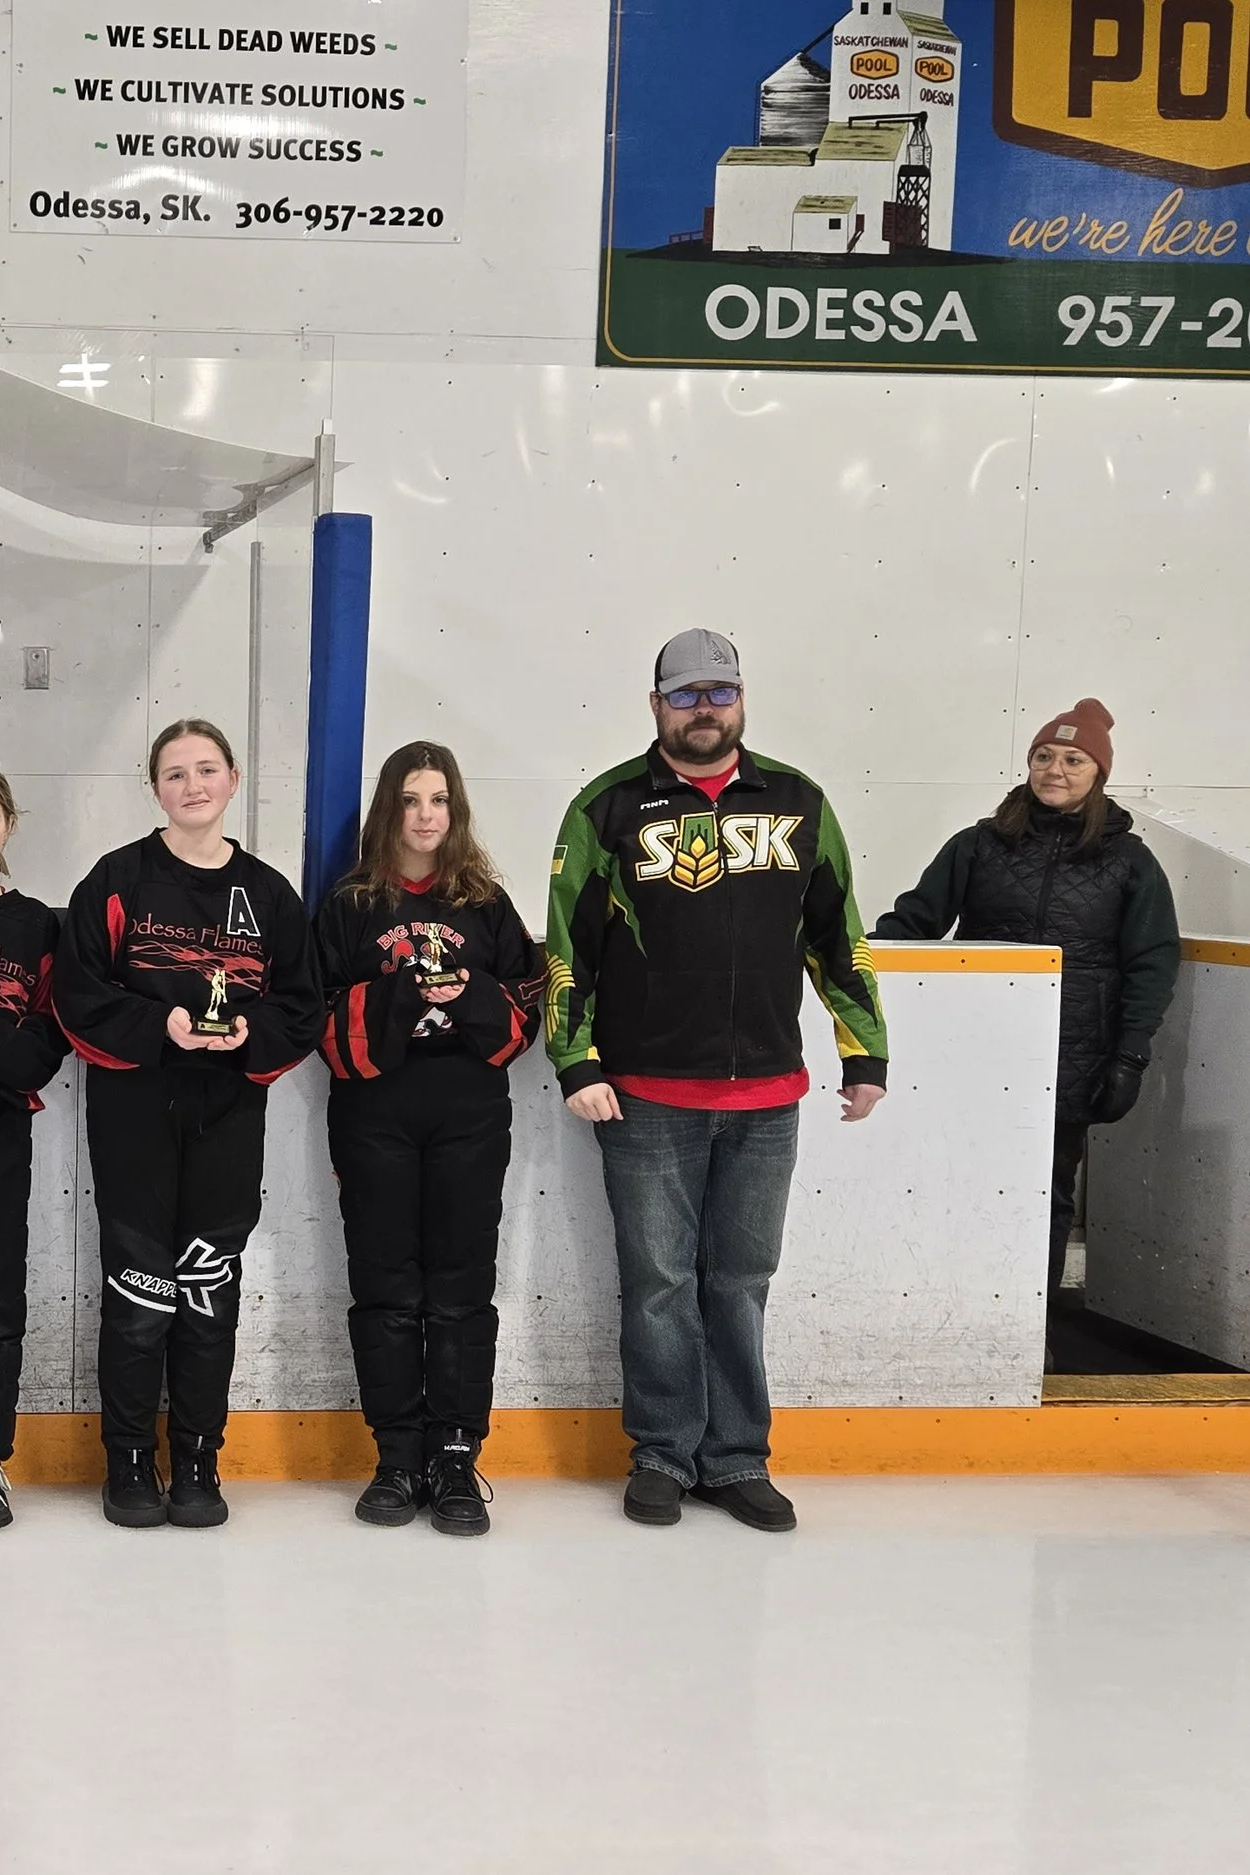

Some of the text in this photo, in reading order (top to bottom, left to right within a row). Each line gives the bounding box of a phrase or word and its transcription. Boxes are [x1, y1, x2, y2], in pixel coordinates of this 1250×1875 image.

[106, 25, 376, 56] WE SELL DEAD WEEDS
[833, 35, 908, 48] SASKATCHEWAN
[856, 57, 892, 71] POOL
[919, 61, 948, 76] POOL
[1067, 0, 1250, 121] PO
[74, 78, 406, 110] WE CULTIVATE SOLUTIONS
[849, 83, 900, 100] ODESSA
[920, 88, 954, 107] ODESSA
[116, 134, 362, 162] WE GROW SUCCESS
[29, 190, 444, 232] Odessa, SK. 306-957-2220
[1008, 187, 1239, 257] we're here
[704, 284, 1250, 348] ODESSA 957-2
[226, 886, 261, 937] A
[376, 924, 409, 951] BIG
[120, 1268, 177, 1298] KNAPP
